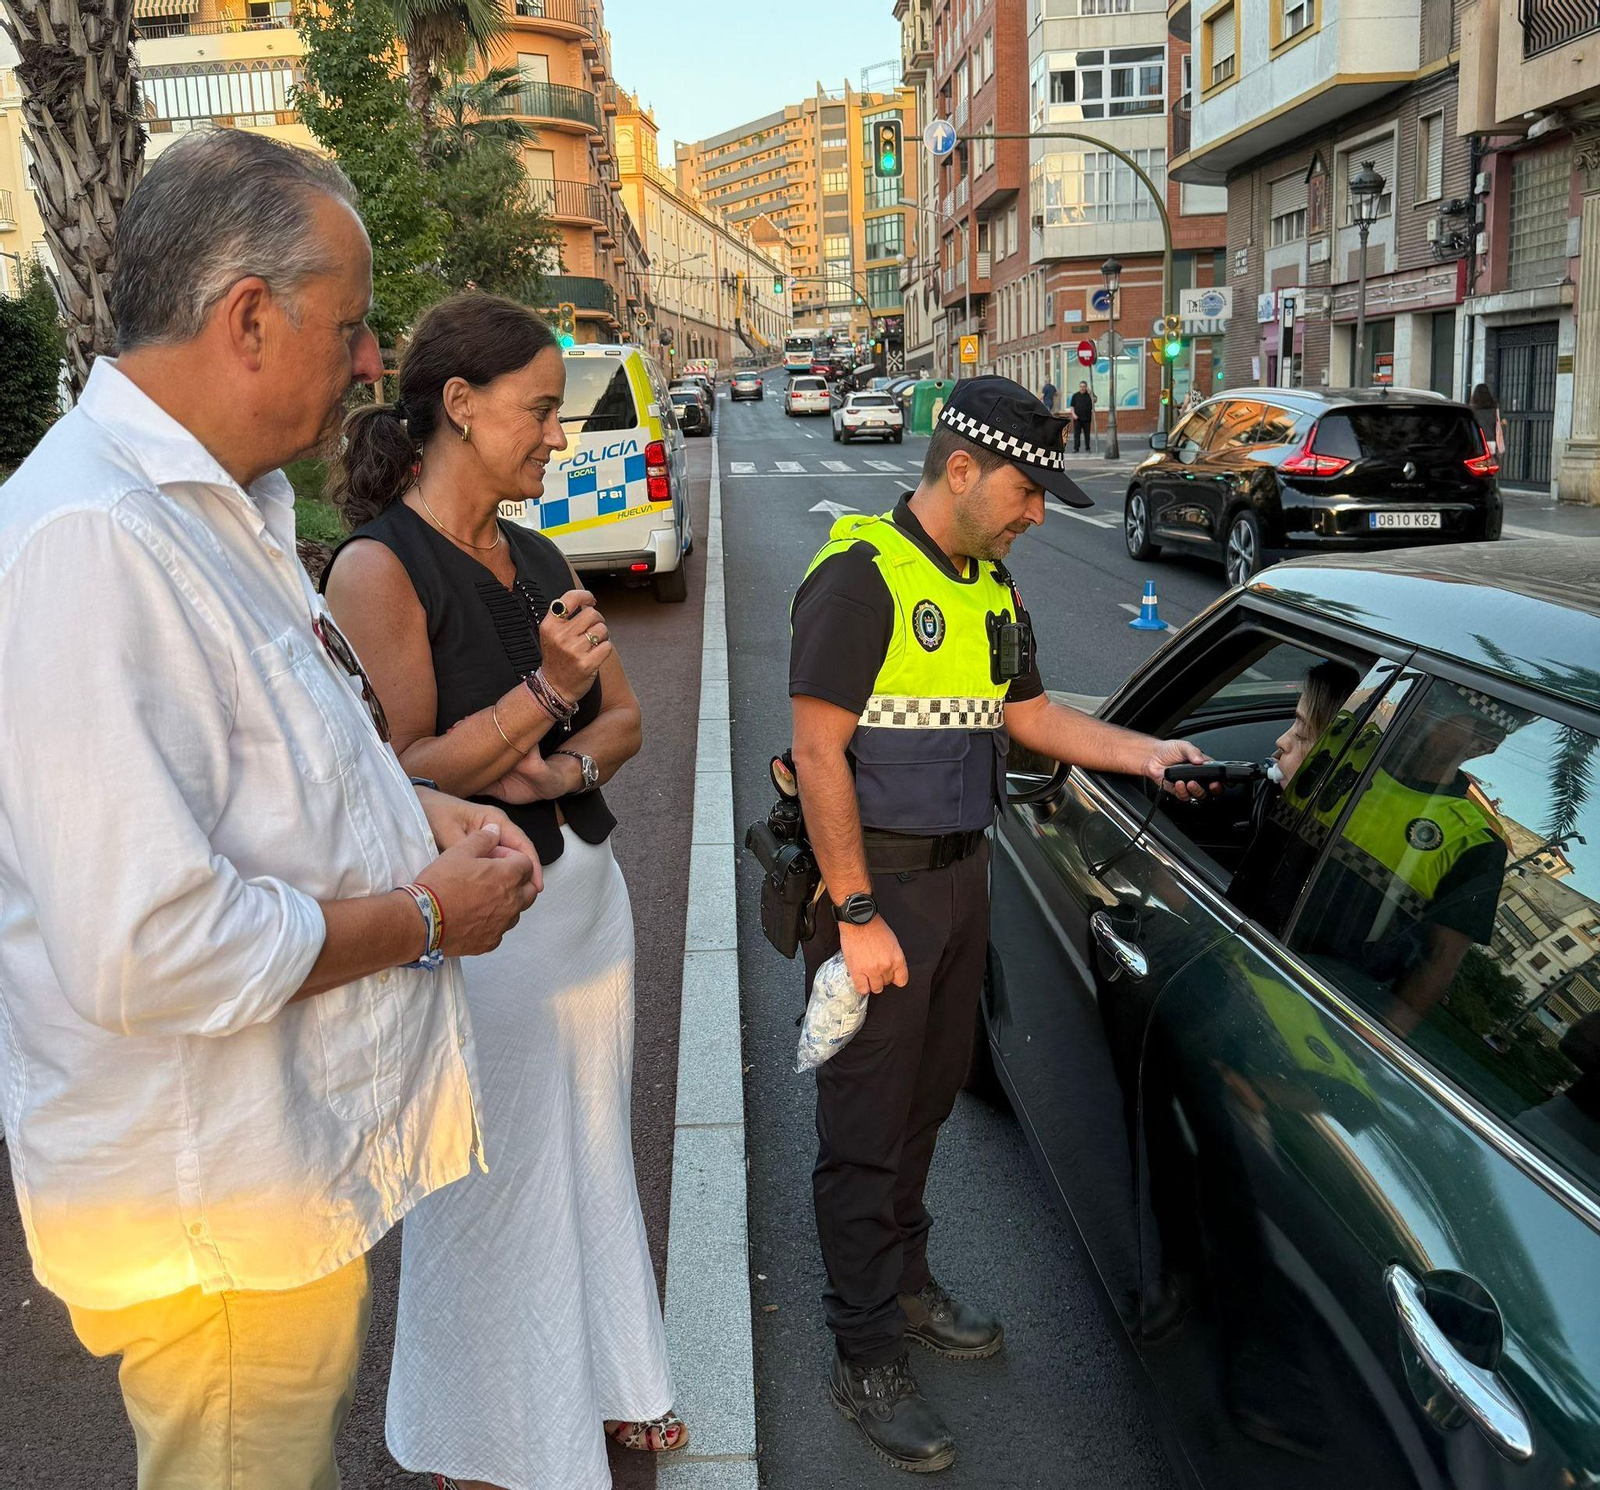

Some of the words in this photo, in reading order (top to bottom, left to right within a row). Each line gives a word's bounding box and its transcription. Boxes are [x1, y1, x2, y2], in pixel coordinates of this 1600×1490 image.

[558, 439, 638, 471] POLICÍA
[568, 468, 596, 479] LOCAL
[599, 491, 608, 500] F
[617, 504, 654, 520] HUELVA
[1378, 514, 1411, 526] 0810
[1414, 514, 1438, 526] KBZ
